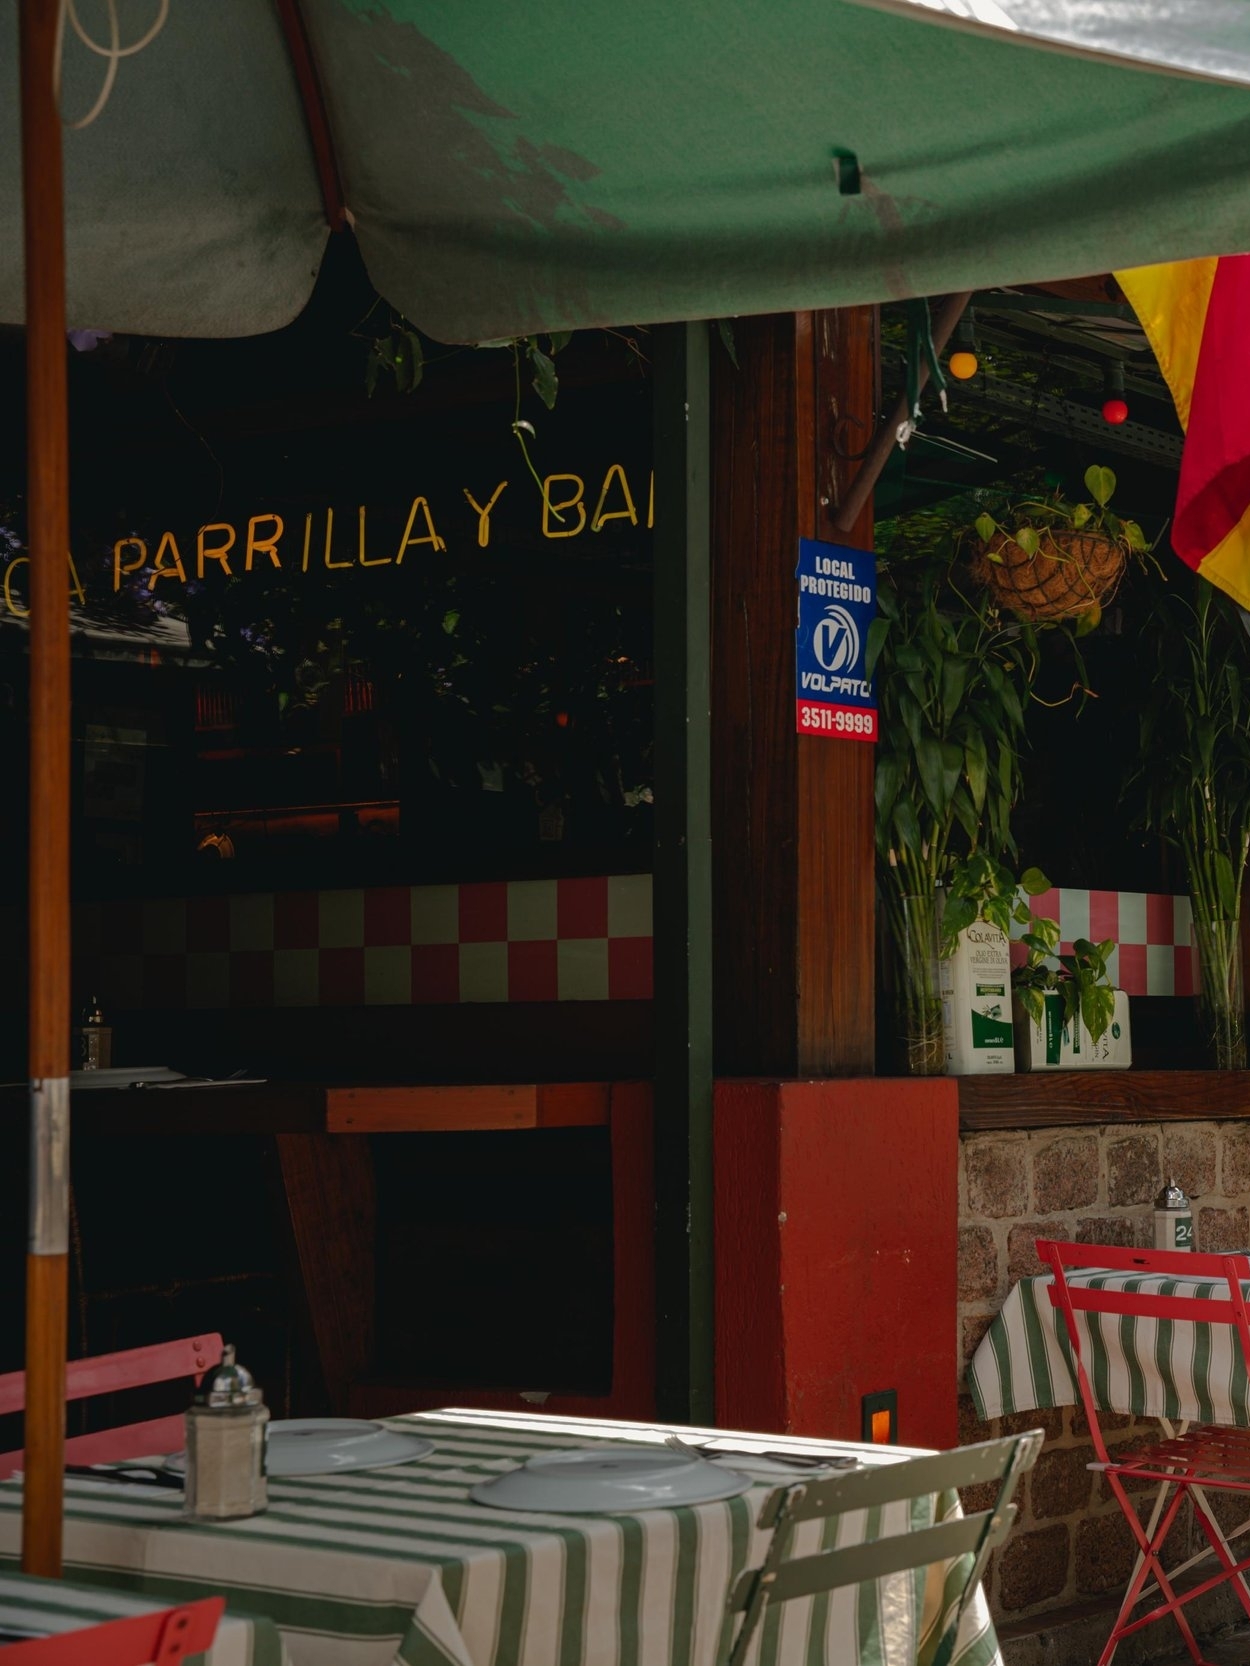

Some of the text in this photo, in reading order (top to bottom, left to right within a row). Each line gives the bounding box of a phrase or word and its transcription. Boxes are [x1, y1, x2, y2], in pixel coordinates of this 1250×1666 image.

[113, 497, 447, 594] PARRILLA
[463, 481, 508, 548] Y
[542, 465, 654, 538] BA
[816, 557, 855, 580] LOCAL
[801, 575, 871, 604] PROTEGIDO
[801, 706, 873, 734] 3511-9999
